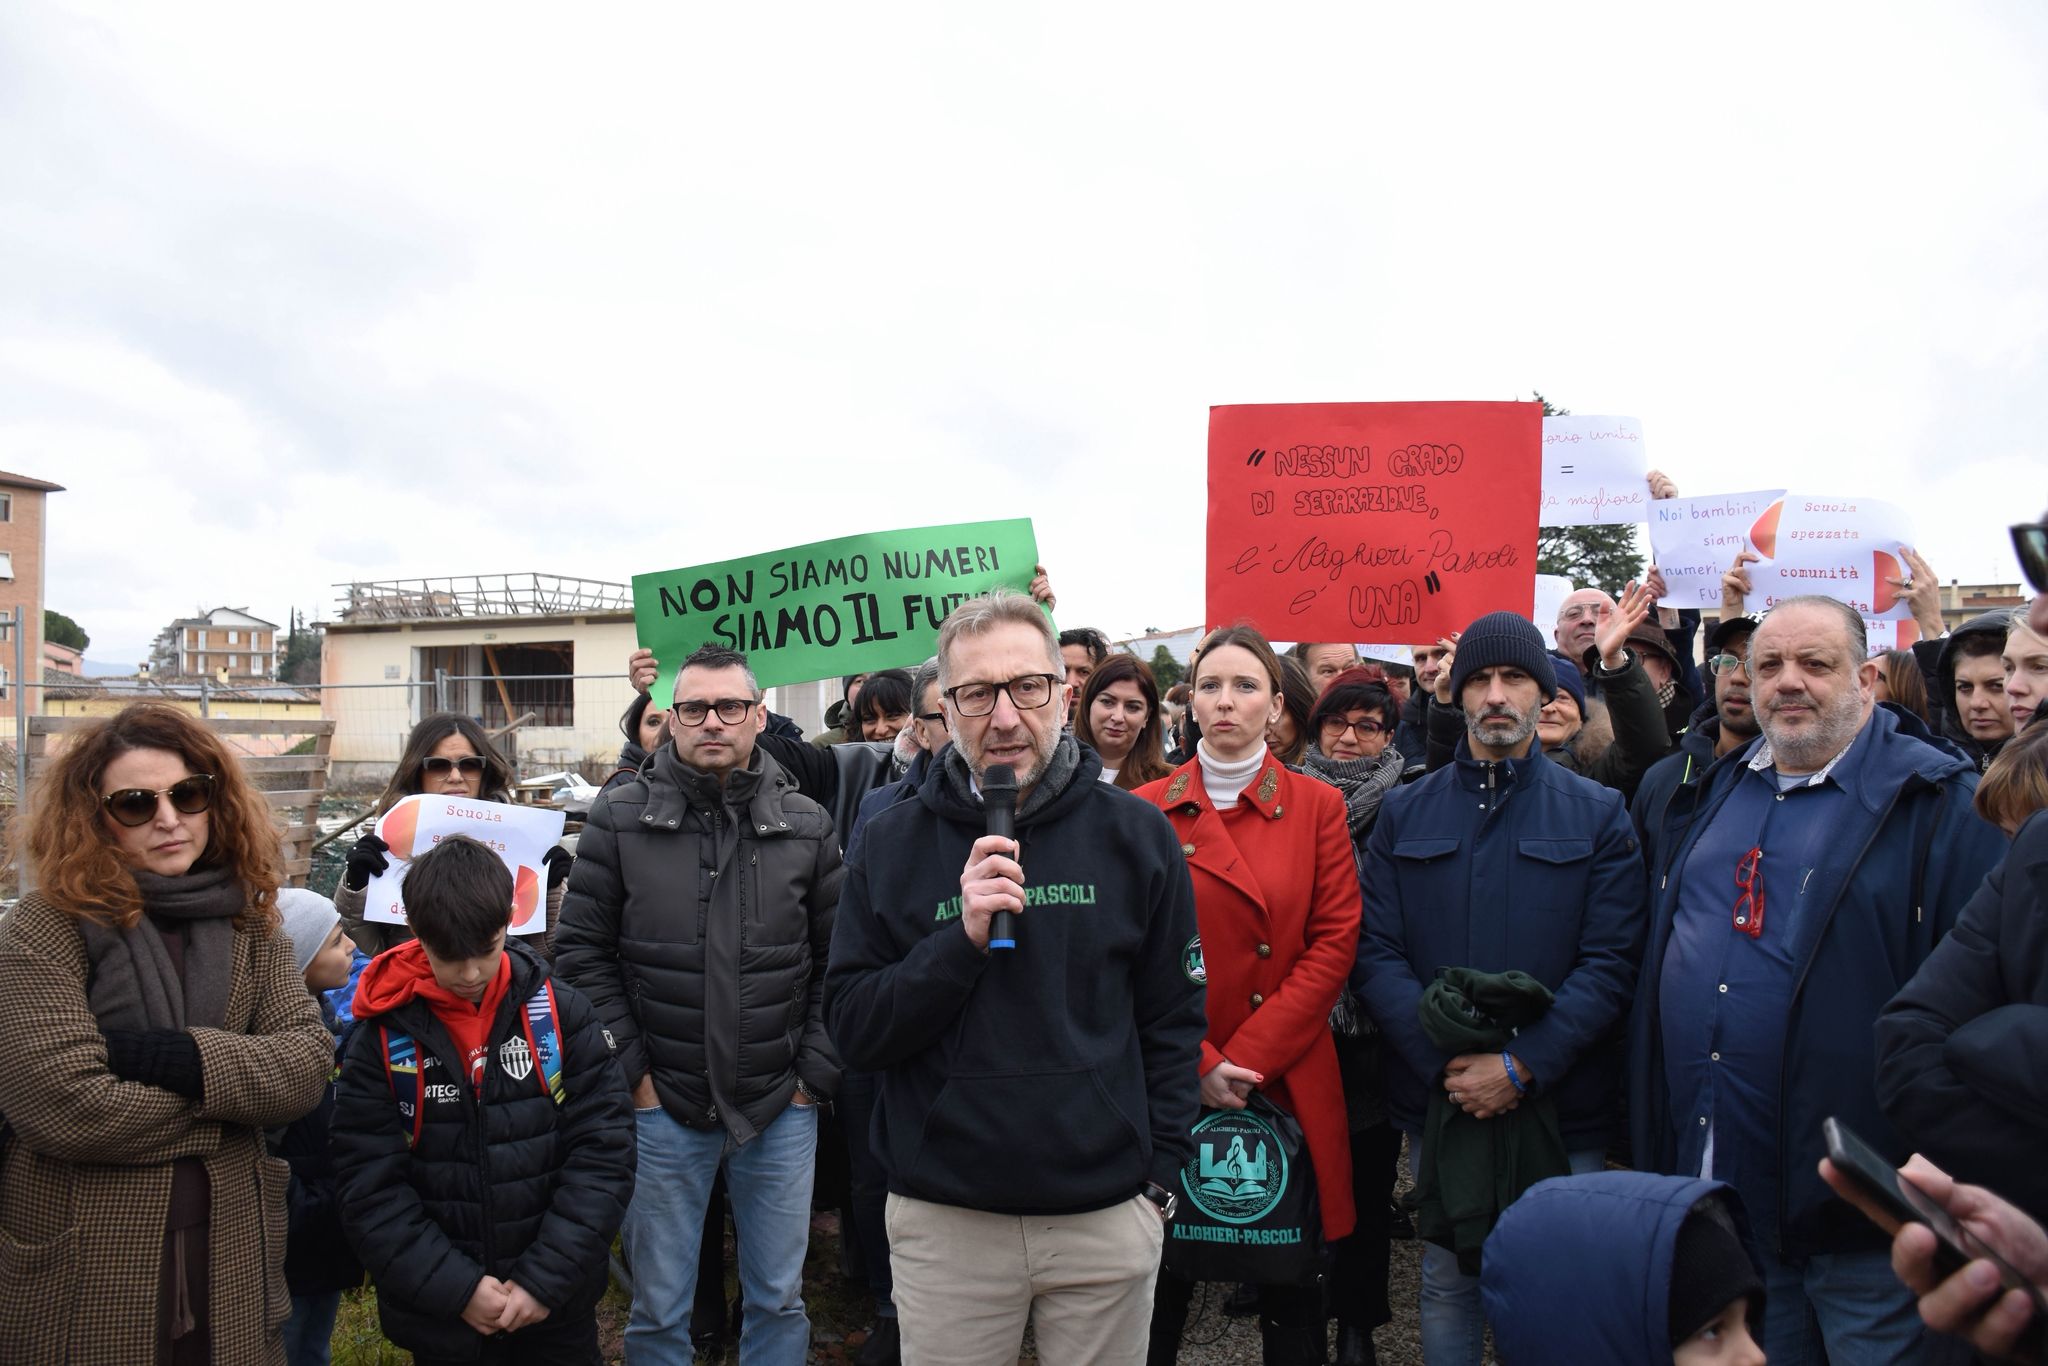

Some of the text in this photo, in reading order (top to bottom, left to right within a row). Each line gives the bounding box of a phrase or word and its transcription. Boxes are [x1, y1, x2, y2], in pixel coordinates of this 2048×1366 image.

[1589, 424, 1641, 443] unito
[1388, 443, 1464, 477] GRADO
[1251, 484, 1439, 520] DI SEPARAZIONE,
[1567, 486, 1644, 521] migliore
[1659, 500, 1758, 523] Noi bambini
[1804, 502, 1858, 514] Scuola
[1790, 528, 1861, 541] spezzata
[659, 546, 1000, 618] NON SIAMO NUMERI
[1780, 565, 1860, 580] comunità
[713, 604, 841, 652] SIAMO
[843, 592, 898, 645] IL
[446, 805, 503, 822] Scuola
[1172, 1223, 1302, 1245] ALIGHIERI-PASCOLI
